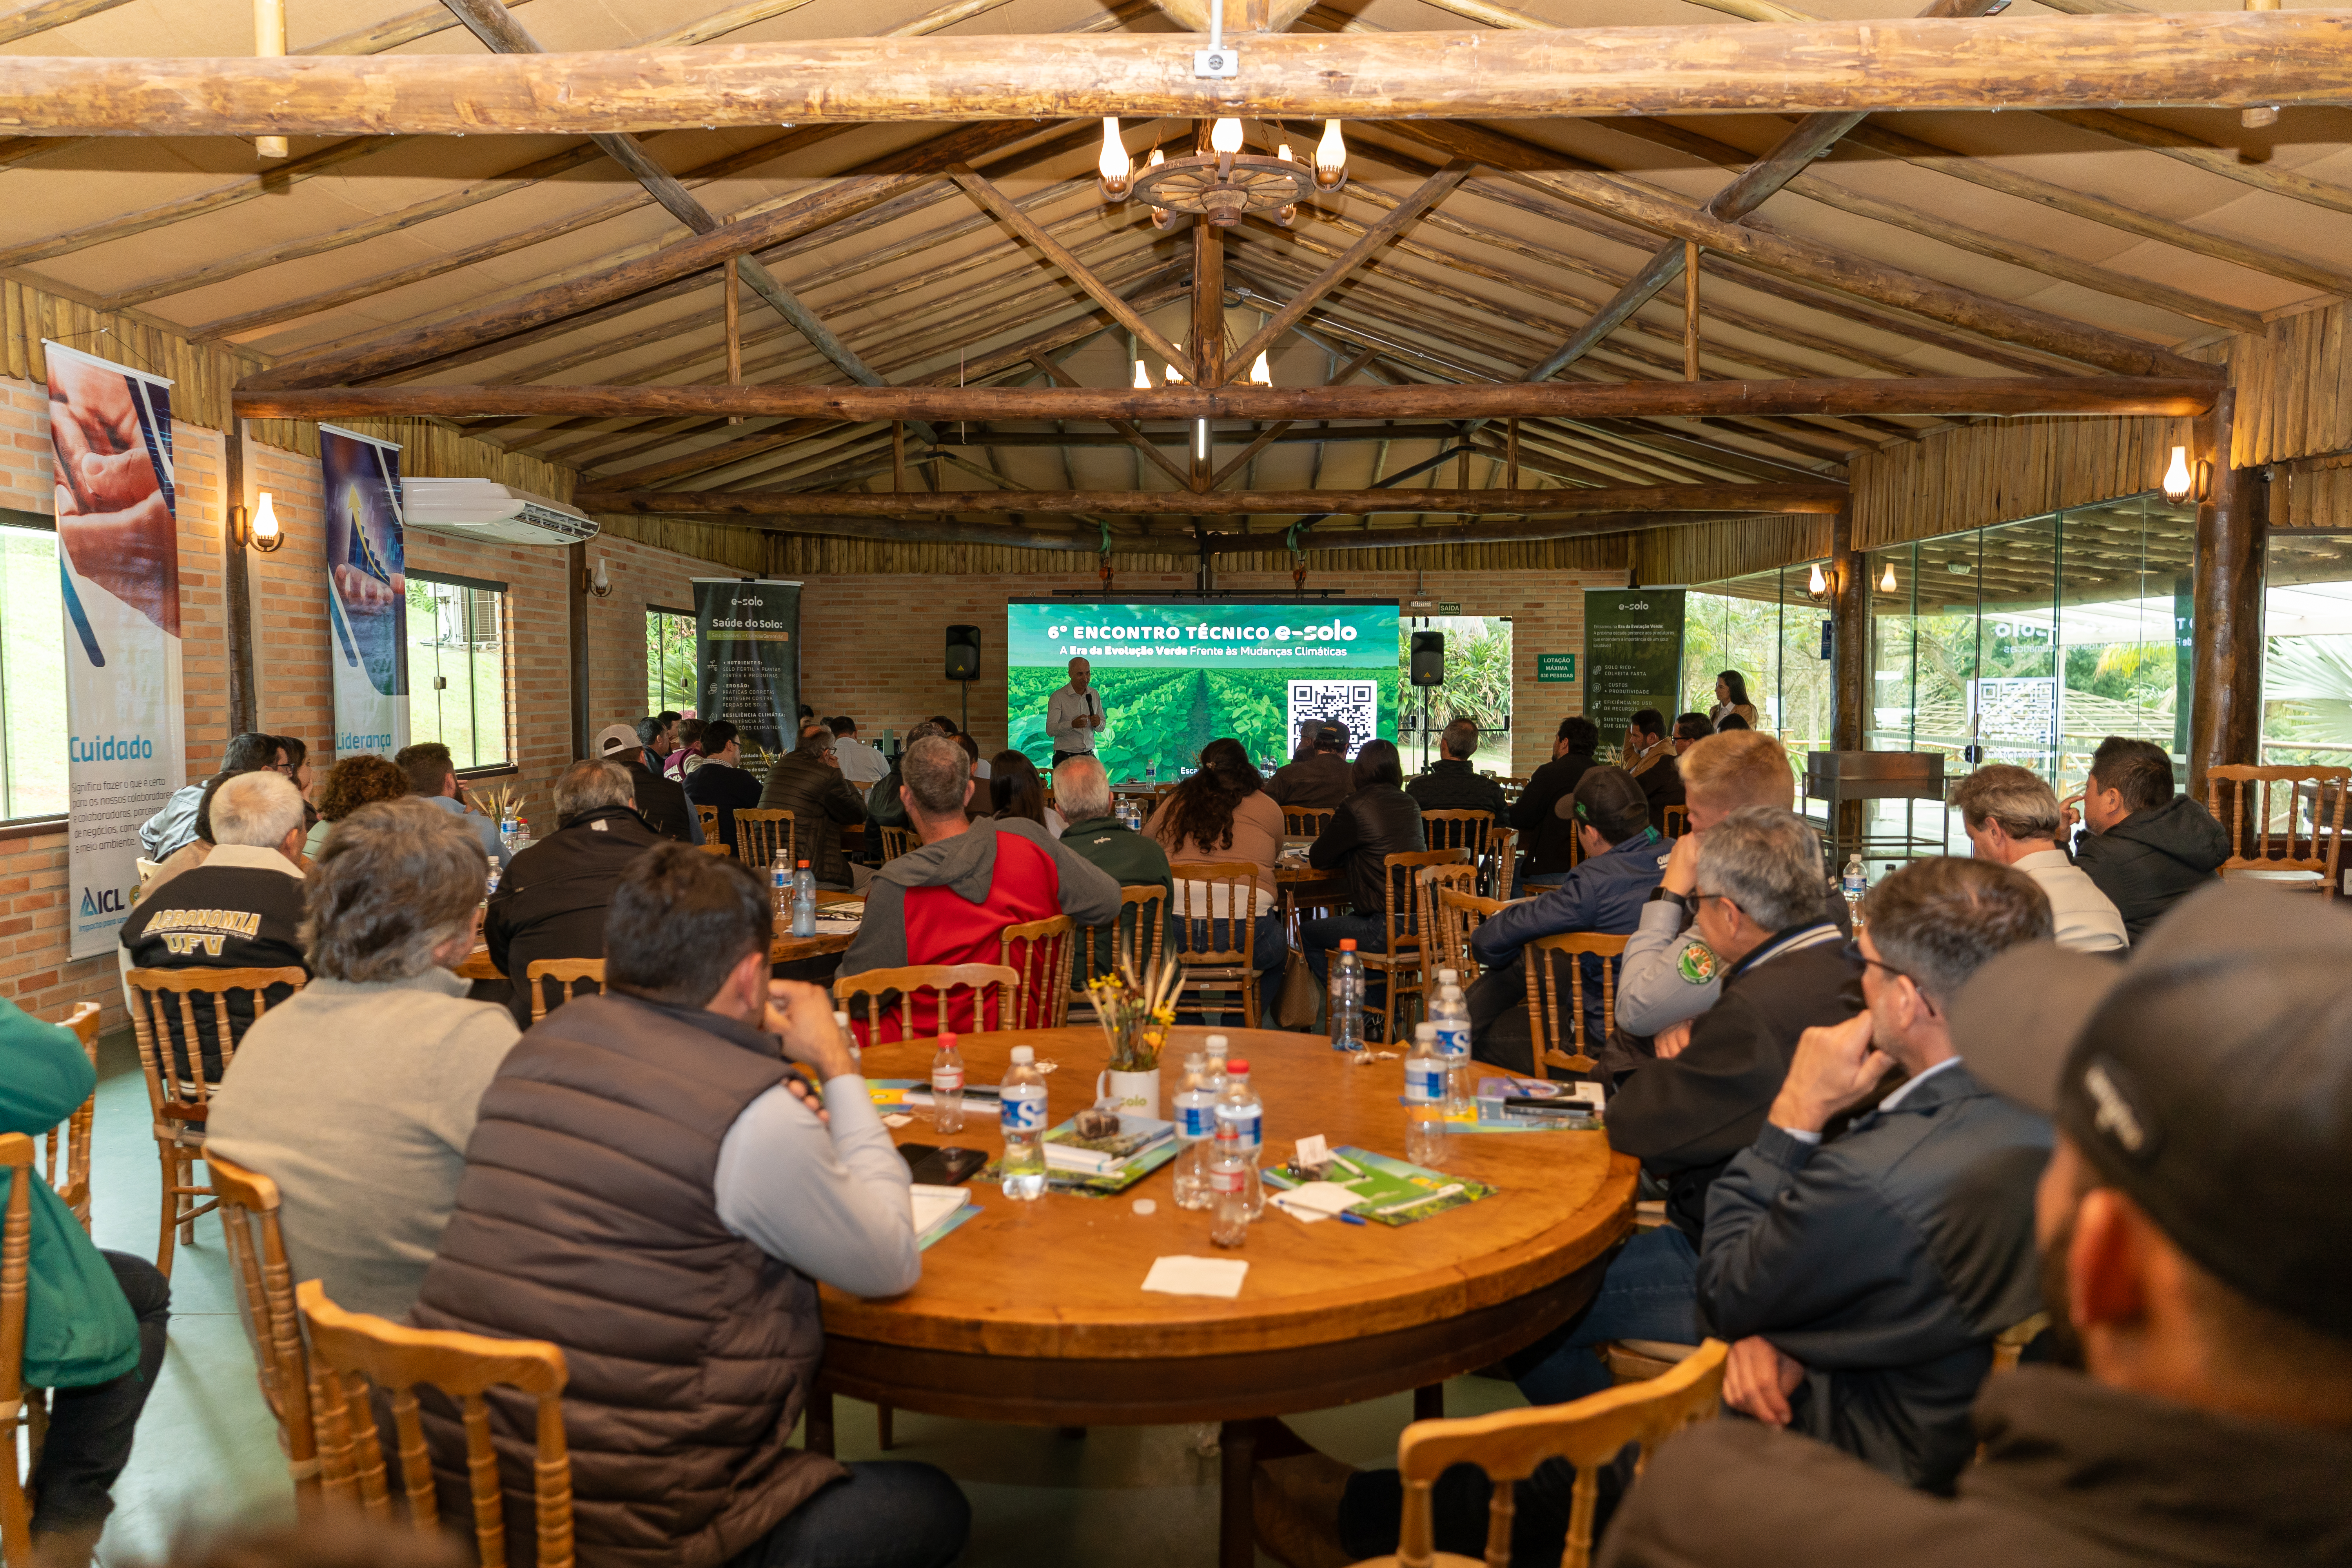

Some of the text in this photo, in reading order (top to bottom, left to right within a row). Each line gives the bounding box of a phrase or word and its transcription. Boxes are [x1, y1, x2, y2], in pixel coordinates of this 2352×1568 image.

[731, 596, 763, 606] e-solo
[1619, 601, 1649, 610] e-solo
[713, 618, 783, 629] Saúde do Solo:
[1073, 626, 1180, 639] ENCONTRO
[1185, 622, 1270, 640] TÉCNICO
[1274, 619, 1357, 641] e-solo
[1060, 646, 1347, 657] A Era da Evolução Verde Frente às Mudanças Climáticas
[70, 734, 152, 762] Cuidado
[336, 733, 391, 752] Liderança
[71, 782, 101, 794] Significa
[103, 780, 123, 790] fazer
[130, 780, 142, 789] que
[143, 777, 147, 787] é
[149, 778, 165, 786] certo
[73, 798, 87, 809] para
[100, 796, 126, 805] nossos
[127, 791, 174, 803] colaboradores
[78, 809, 132, 822] colaboradoras,
[74, 829, 82, 838] de
[83, 825, 118, 838] negócios,
[80, 842, 97, 853] meio
[99, 838, 135, 850] ambiente.
[142, 909, 261, 936] AGRONOMIA
[161, 933, 227, 956] UFV
